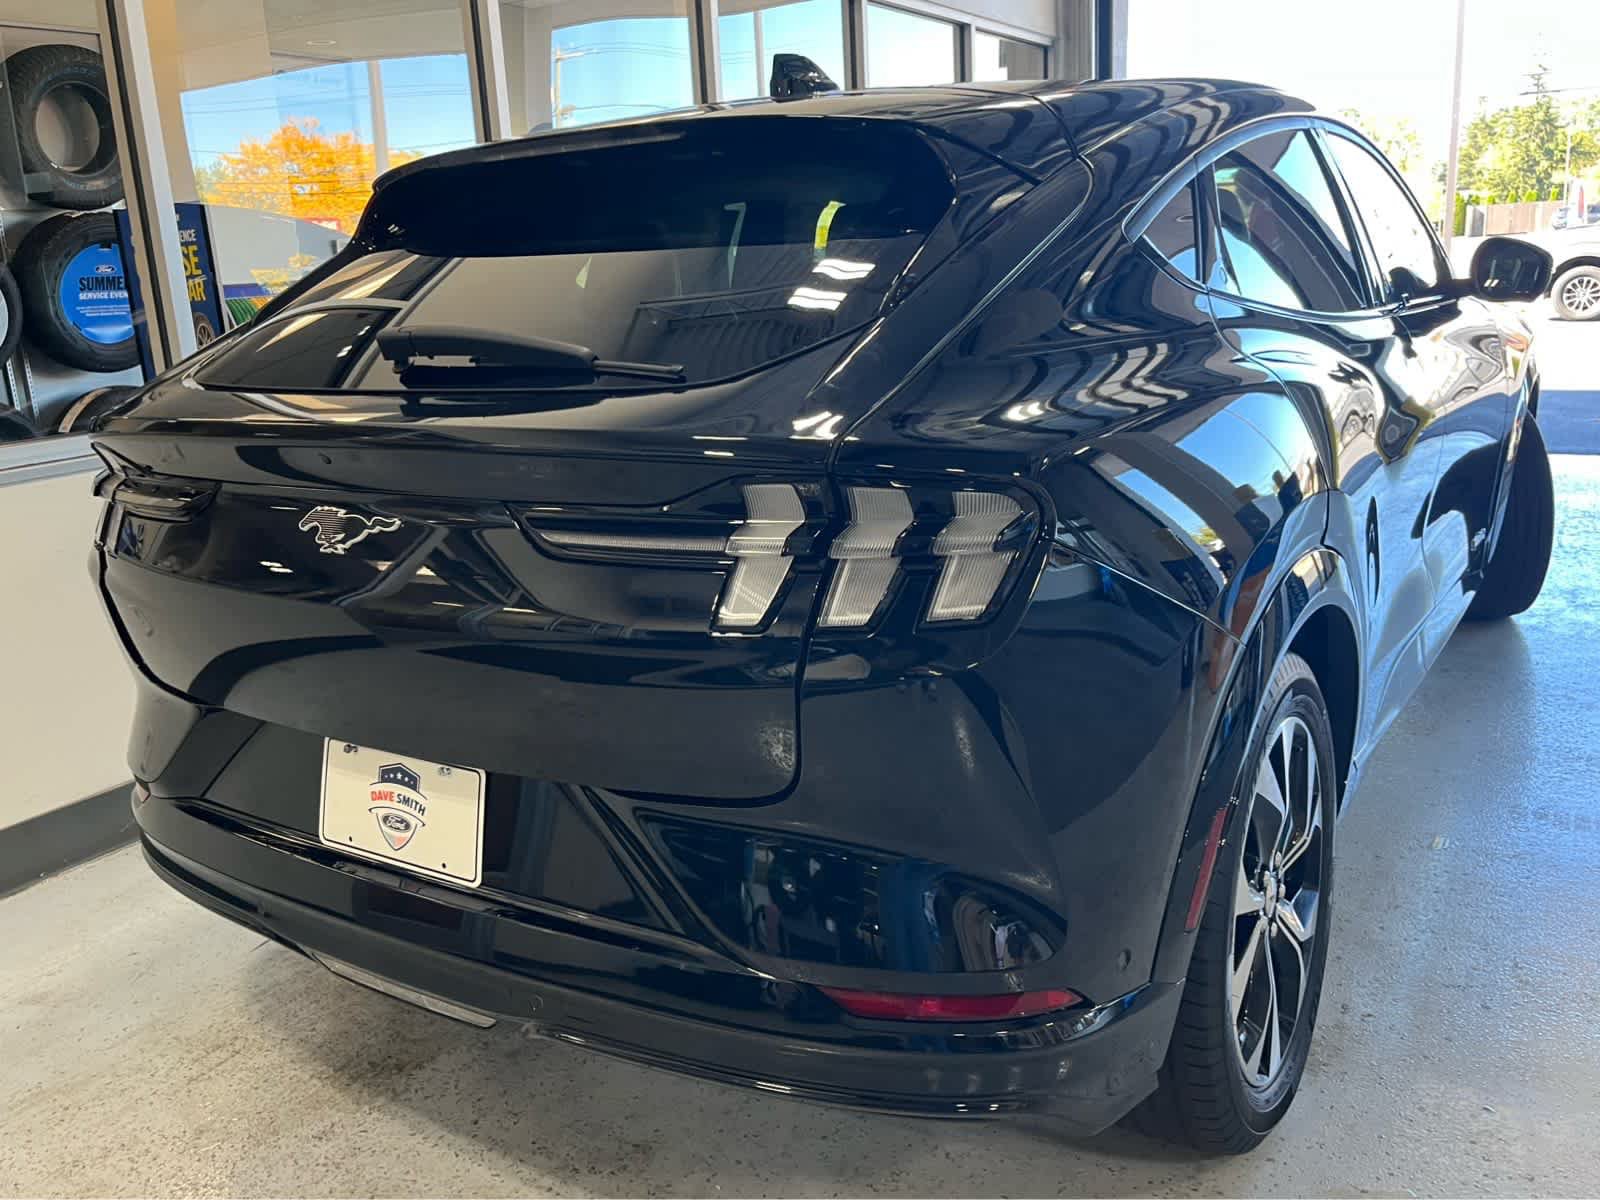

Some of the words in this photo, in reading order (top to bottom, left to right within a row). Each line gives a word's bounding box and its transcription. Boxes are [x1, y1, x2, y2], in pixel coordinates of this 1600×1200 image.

[79, 276, 125, 291] SUMME
[79, 291, 108, 300] SERVICE
[109, 290, 129, 299] EVEN
[371, 790, 395, 802] DAVE
[396, 793, 426, 817] SMITH
